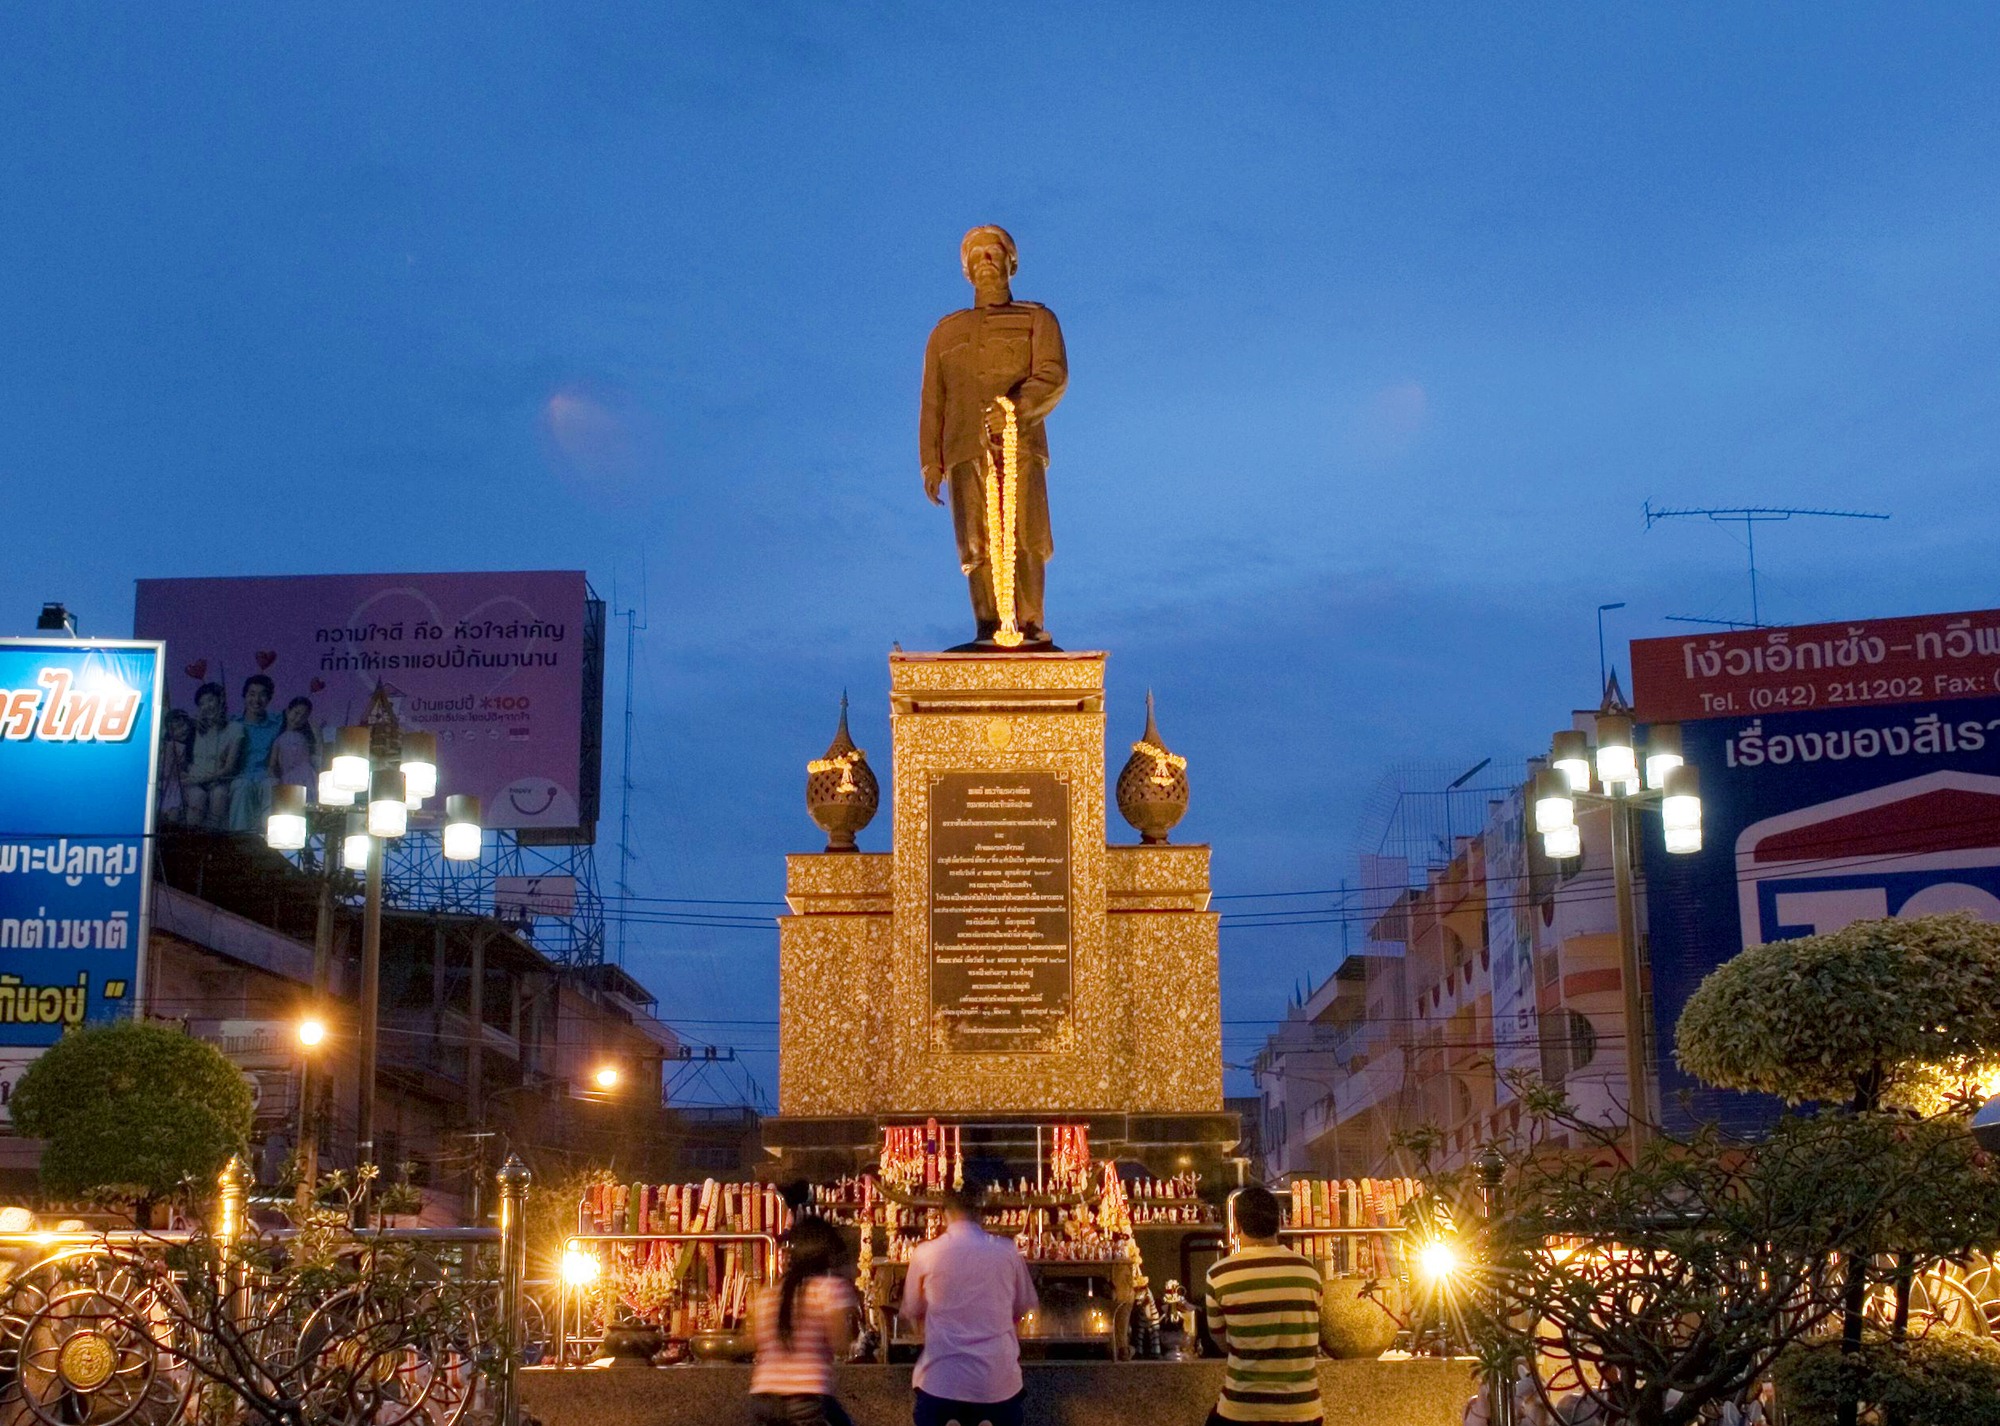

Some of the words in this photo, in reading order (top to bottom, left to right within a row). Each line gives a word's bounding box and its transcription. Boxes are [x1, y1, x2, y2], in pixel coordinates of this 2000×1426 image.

[316, 622, 403, 643] ความใจดี
[414, 620, 443, 641] คือ
[454, 619, 566, 642] หัวใจสำคัญ
[1700, 693, 1739, 712] Tel.
[1749, 684, 1816, 710] (042)
[1828, 677, 1924, 703] 211202
[1934, 674, 1986, 695] Fax:
